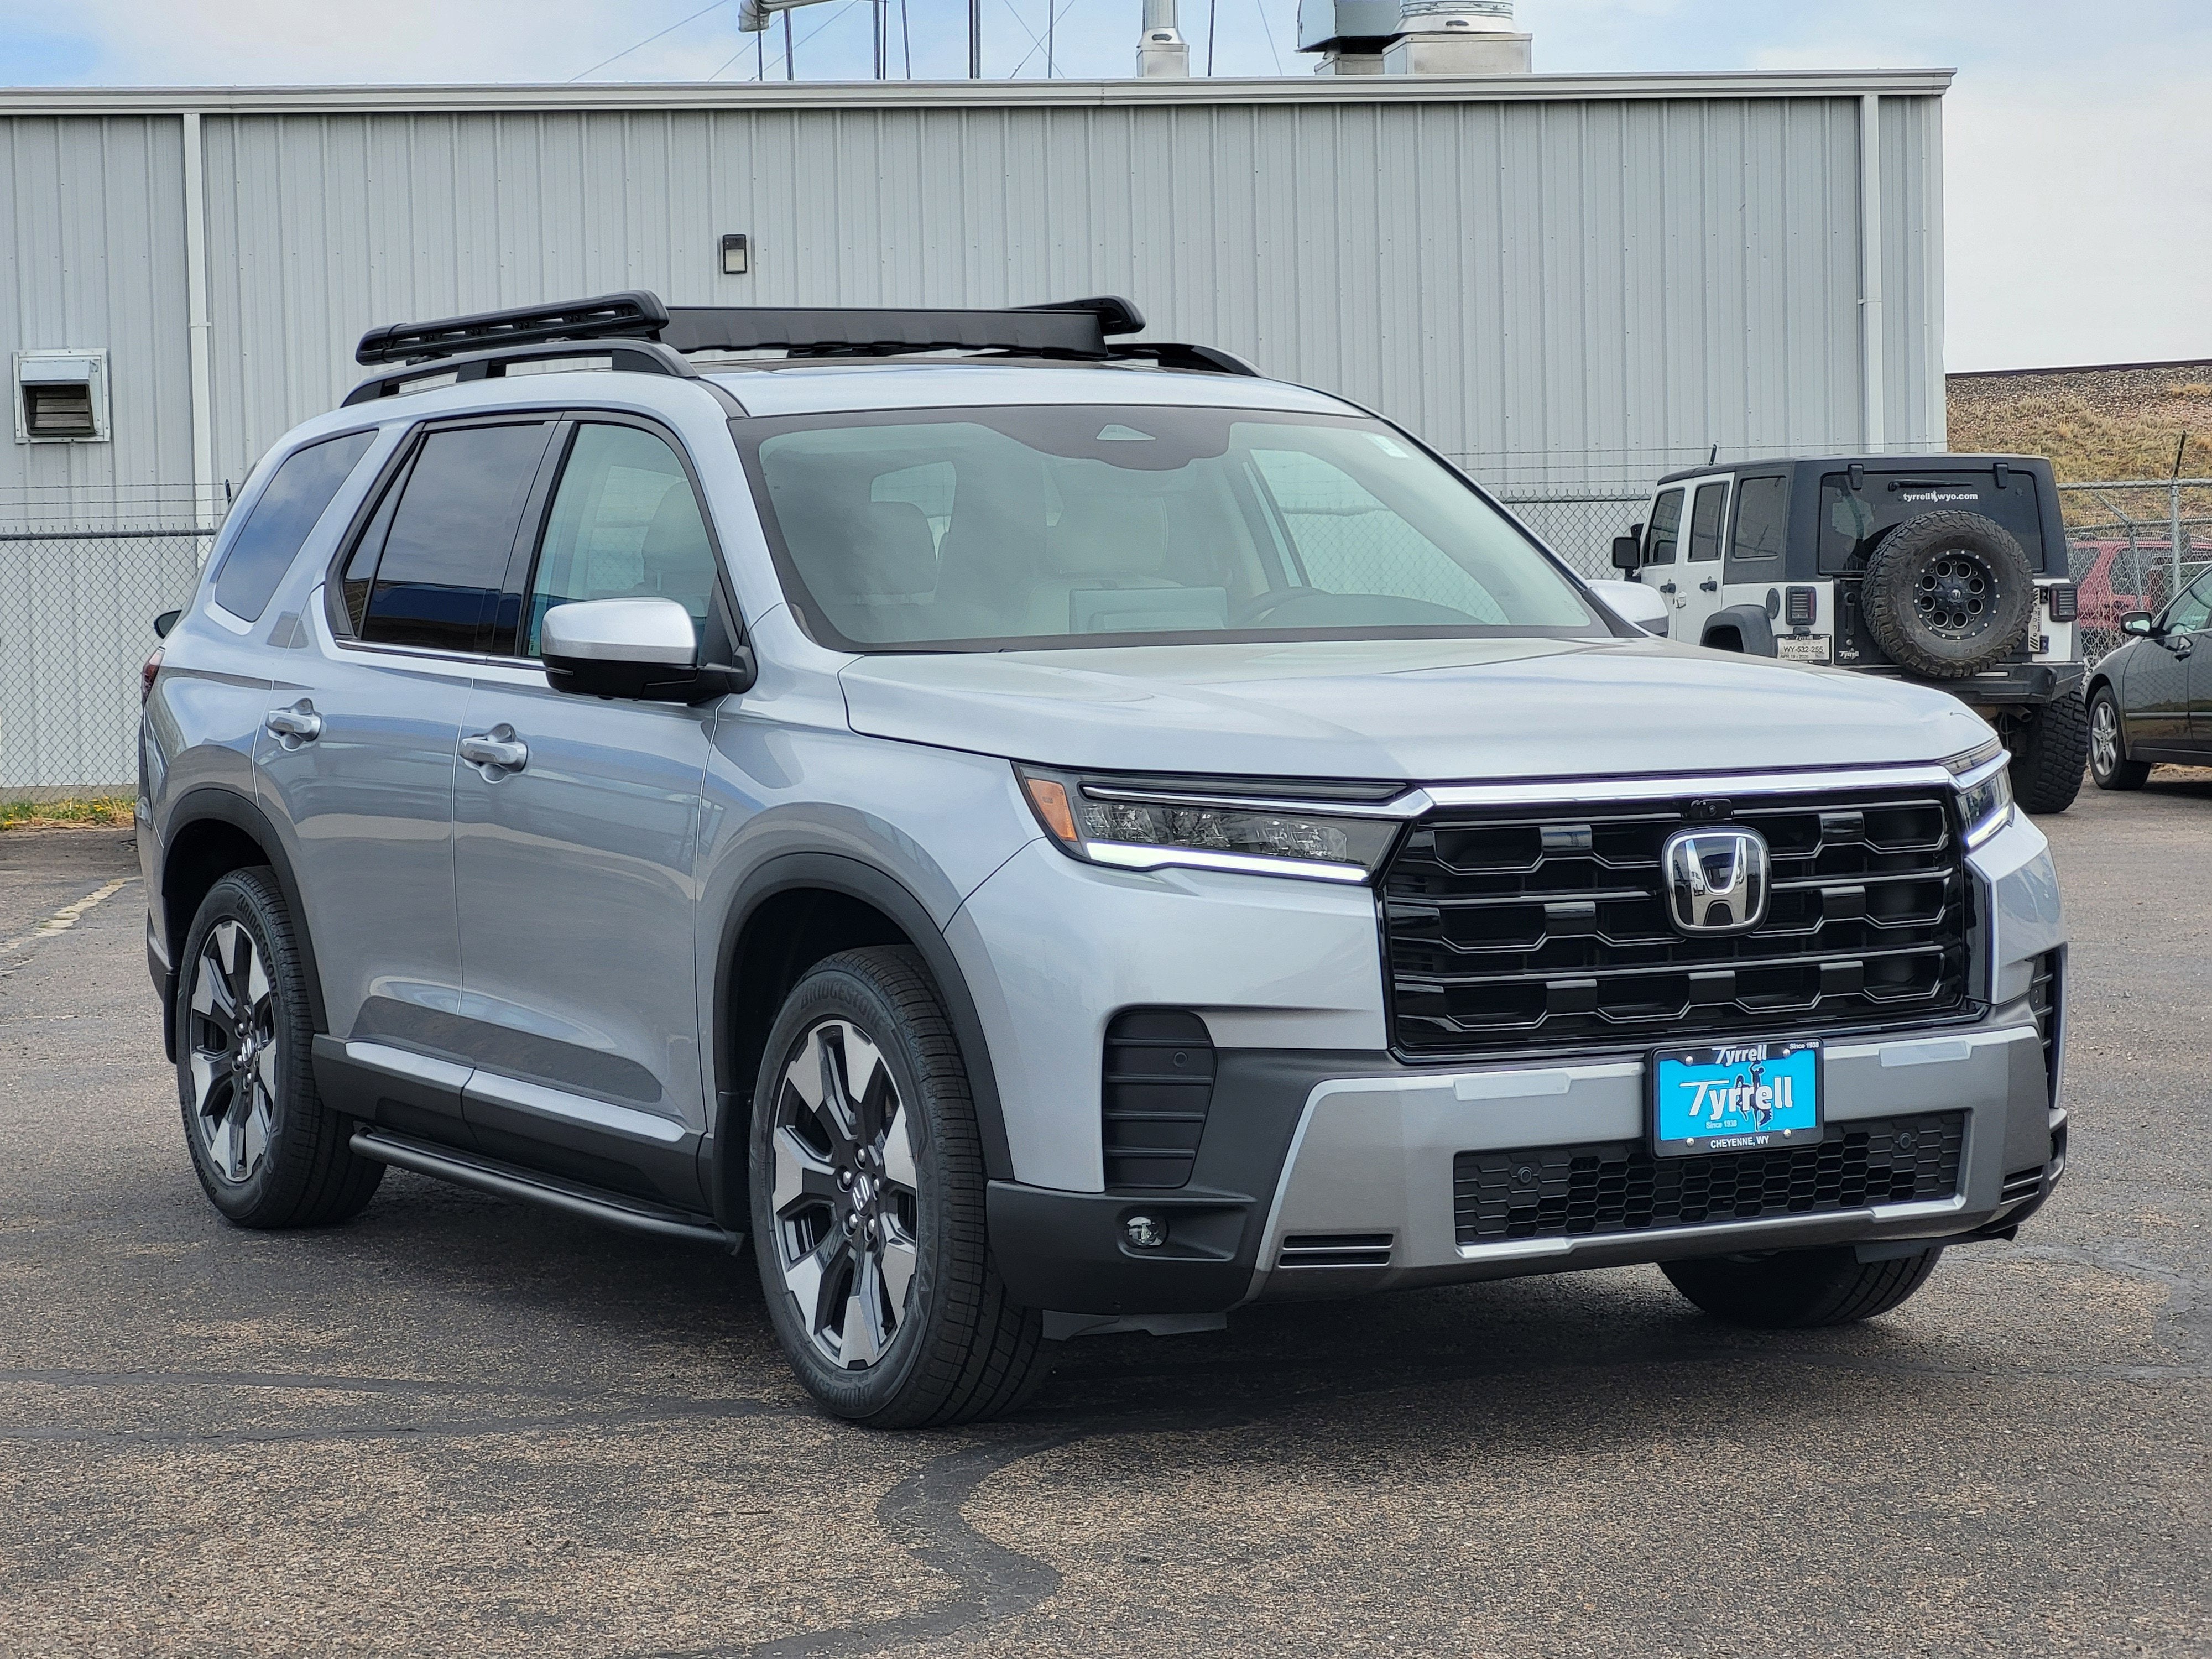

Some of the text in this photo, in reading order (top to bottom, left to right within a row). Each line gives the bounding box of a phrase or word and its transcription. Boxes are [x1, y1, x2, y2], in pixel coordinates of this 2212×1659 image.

[1711, 1044, 1767, 1067] Tyrrell
[1679, 1076, 1794, 1121] Tyrrell
[1705, 1121, 1723, 1129] Since
[1710, 1135, 1770, 1149] CHEYENNE, WY
